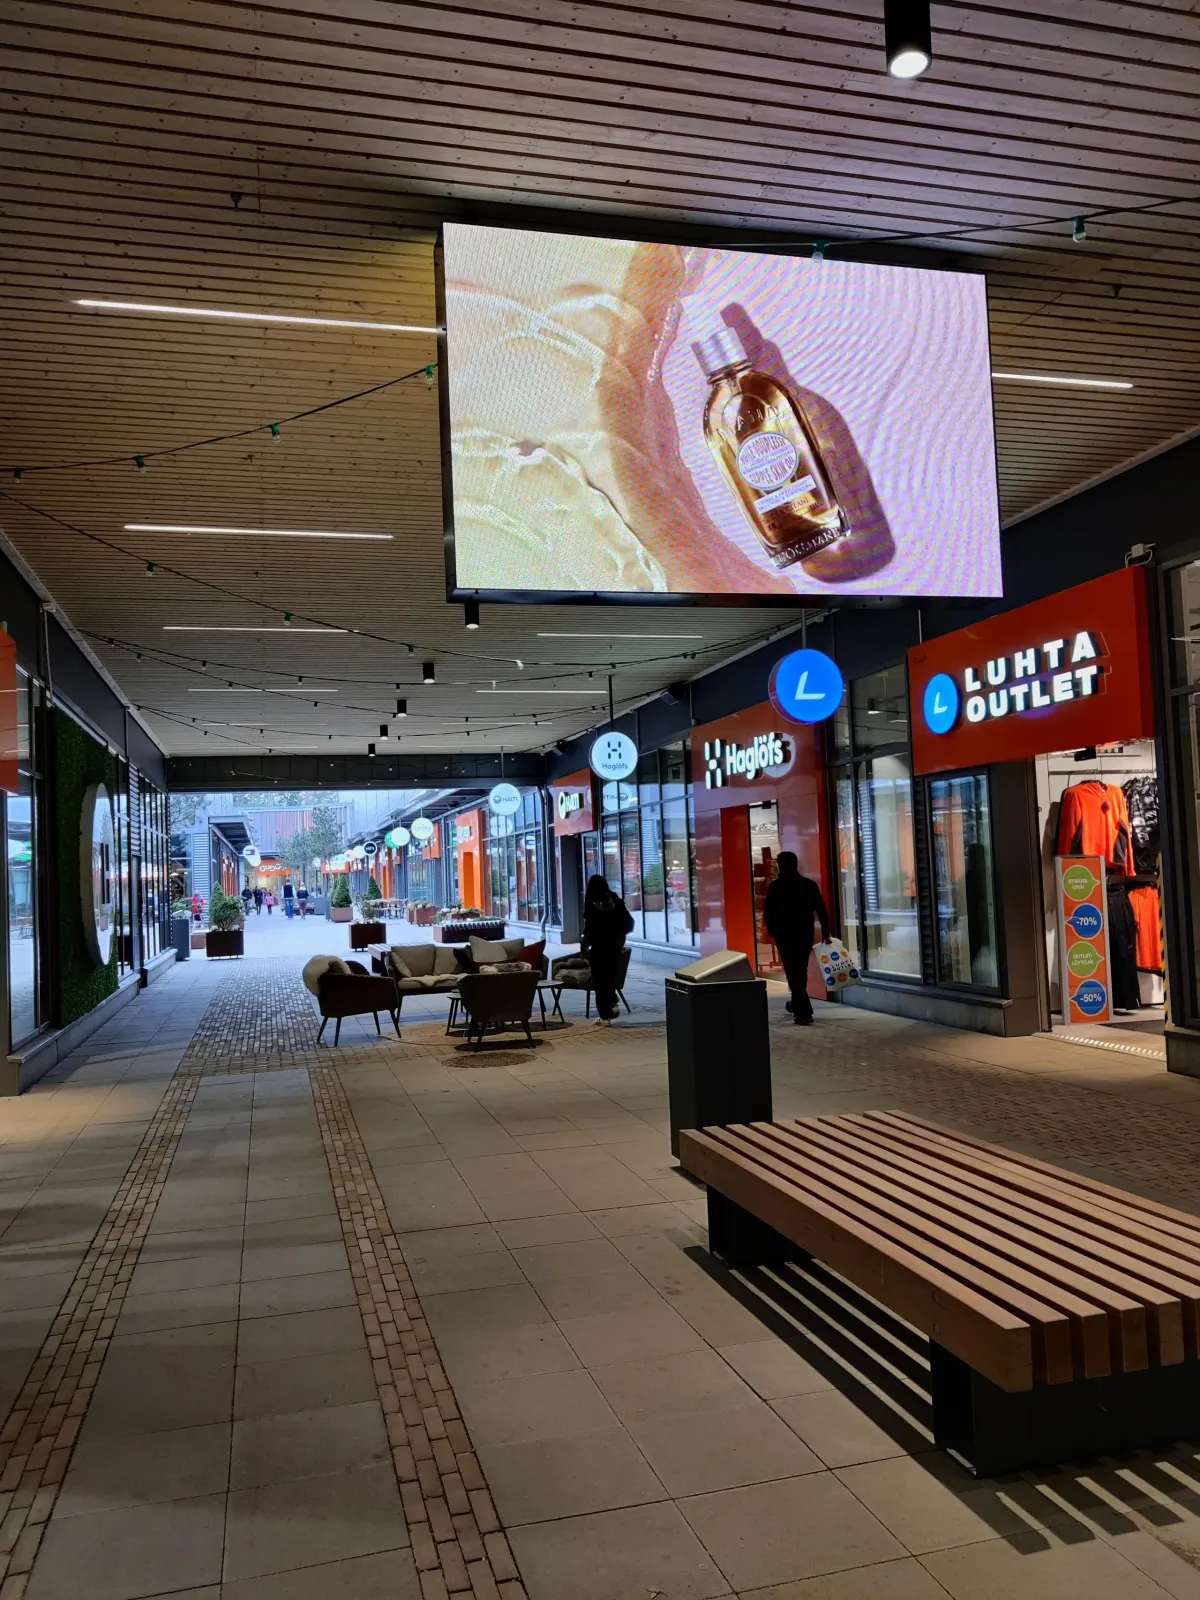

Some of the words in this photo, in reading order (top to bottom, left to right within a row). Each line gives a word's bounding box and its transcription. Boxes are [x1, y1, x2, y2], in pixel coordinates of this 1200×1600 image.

[770, 461, 788, 481] SKIN
[964, 631, 1096, 692] LUHTA
[966, 665, 1098, 723] OUTLET
[726, 731, 784, 779] Haglöfs
[602, 762, 628, 771] Haglöfs
[1076, 917, 1098, 926] -70%
[832, 962, 854, 972] OUTLET
[1080, 993, 1102, 1003] -50%
